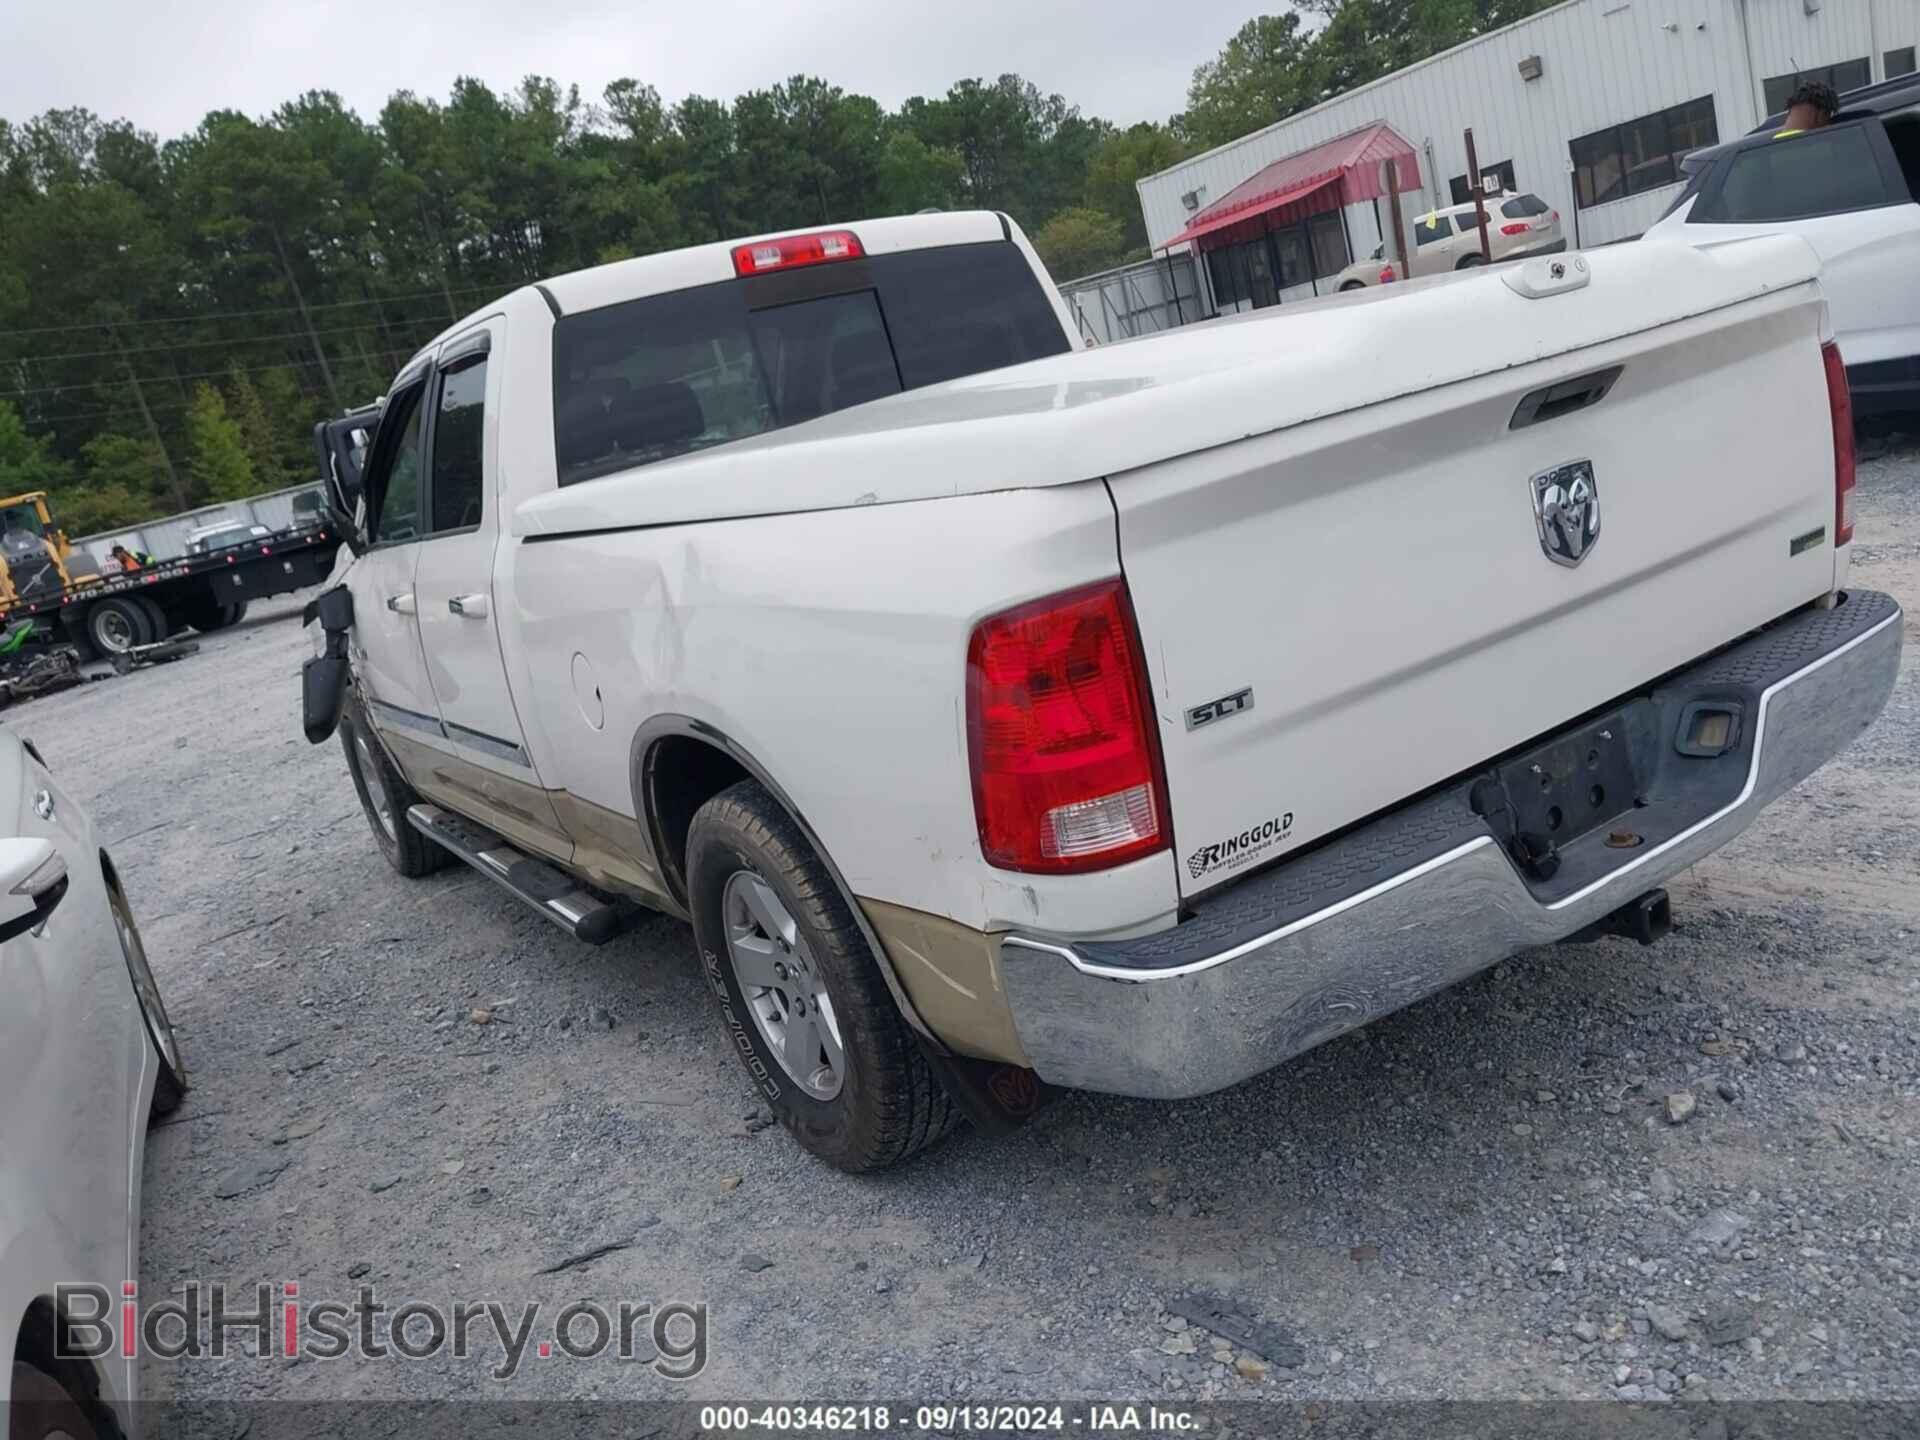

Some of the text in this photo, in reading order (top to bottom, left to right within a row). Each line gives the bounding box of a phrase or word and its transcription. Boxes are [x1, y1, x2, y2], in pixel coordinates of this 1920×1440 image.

[1193, 691, 1249, 725] SLT
[1202, 812, 1294, 866] RINGGOLD
[705, 950, 782, 1100] COOPER
